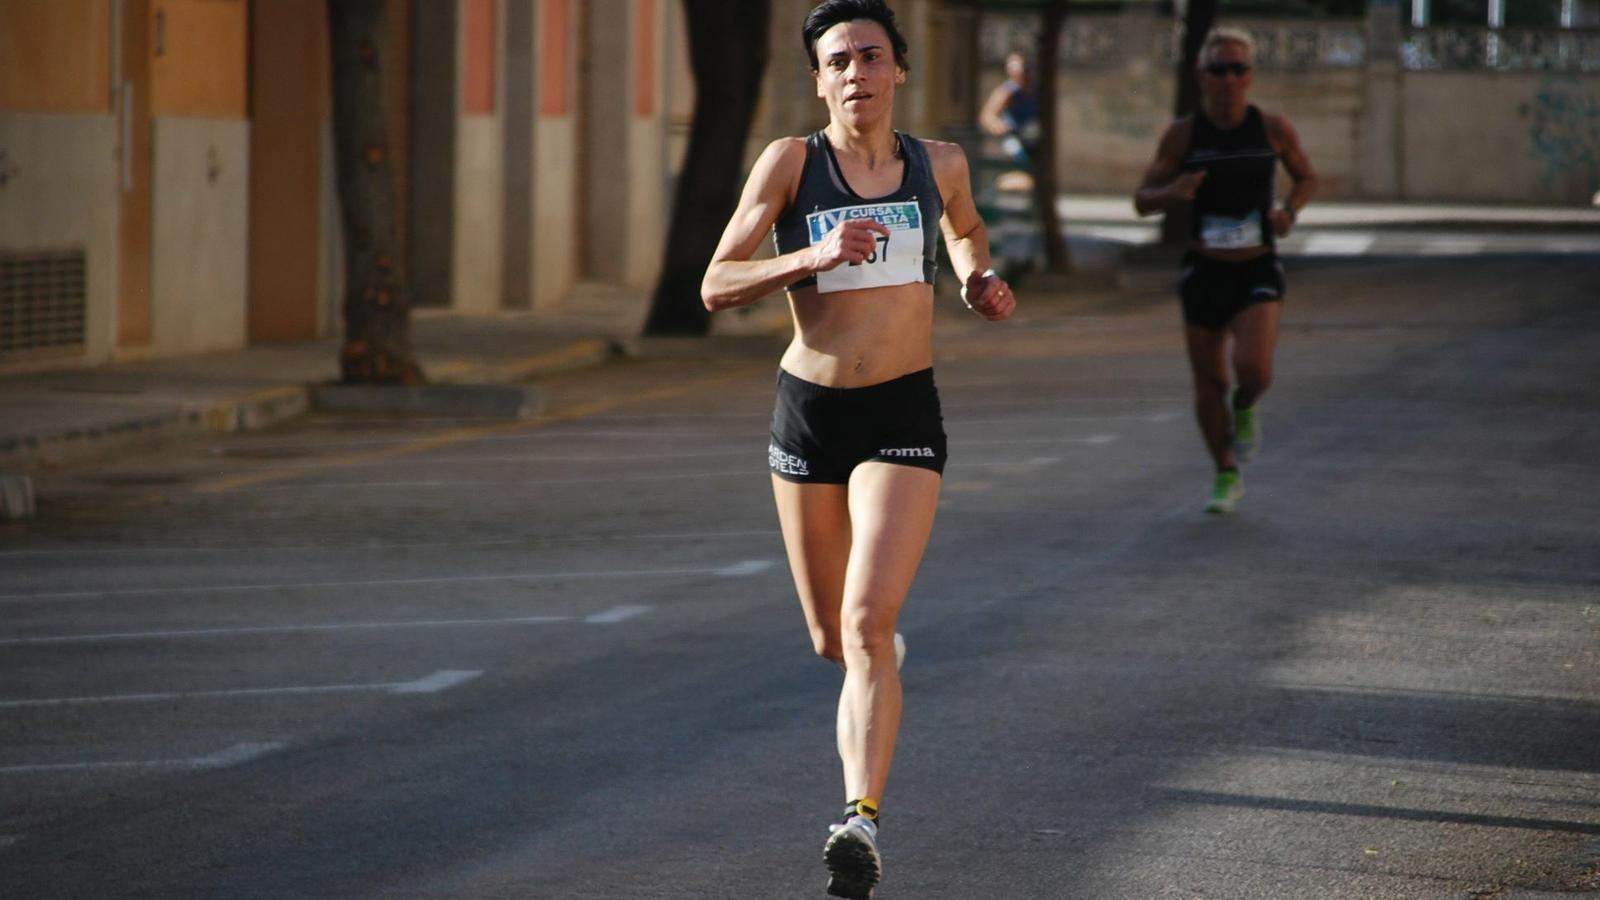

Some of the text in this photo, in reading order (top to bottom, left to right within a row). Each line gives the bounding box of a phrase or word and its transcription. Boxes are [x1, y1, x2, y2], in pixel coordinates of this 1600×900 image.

[850, 205, 894, 218] CURSA
[874, 213, 909, 225] LETA
[768, 444, 807, 470] ARDEN
[768, 455, 809, 475] OTELS
